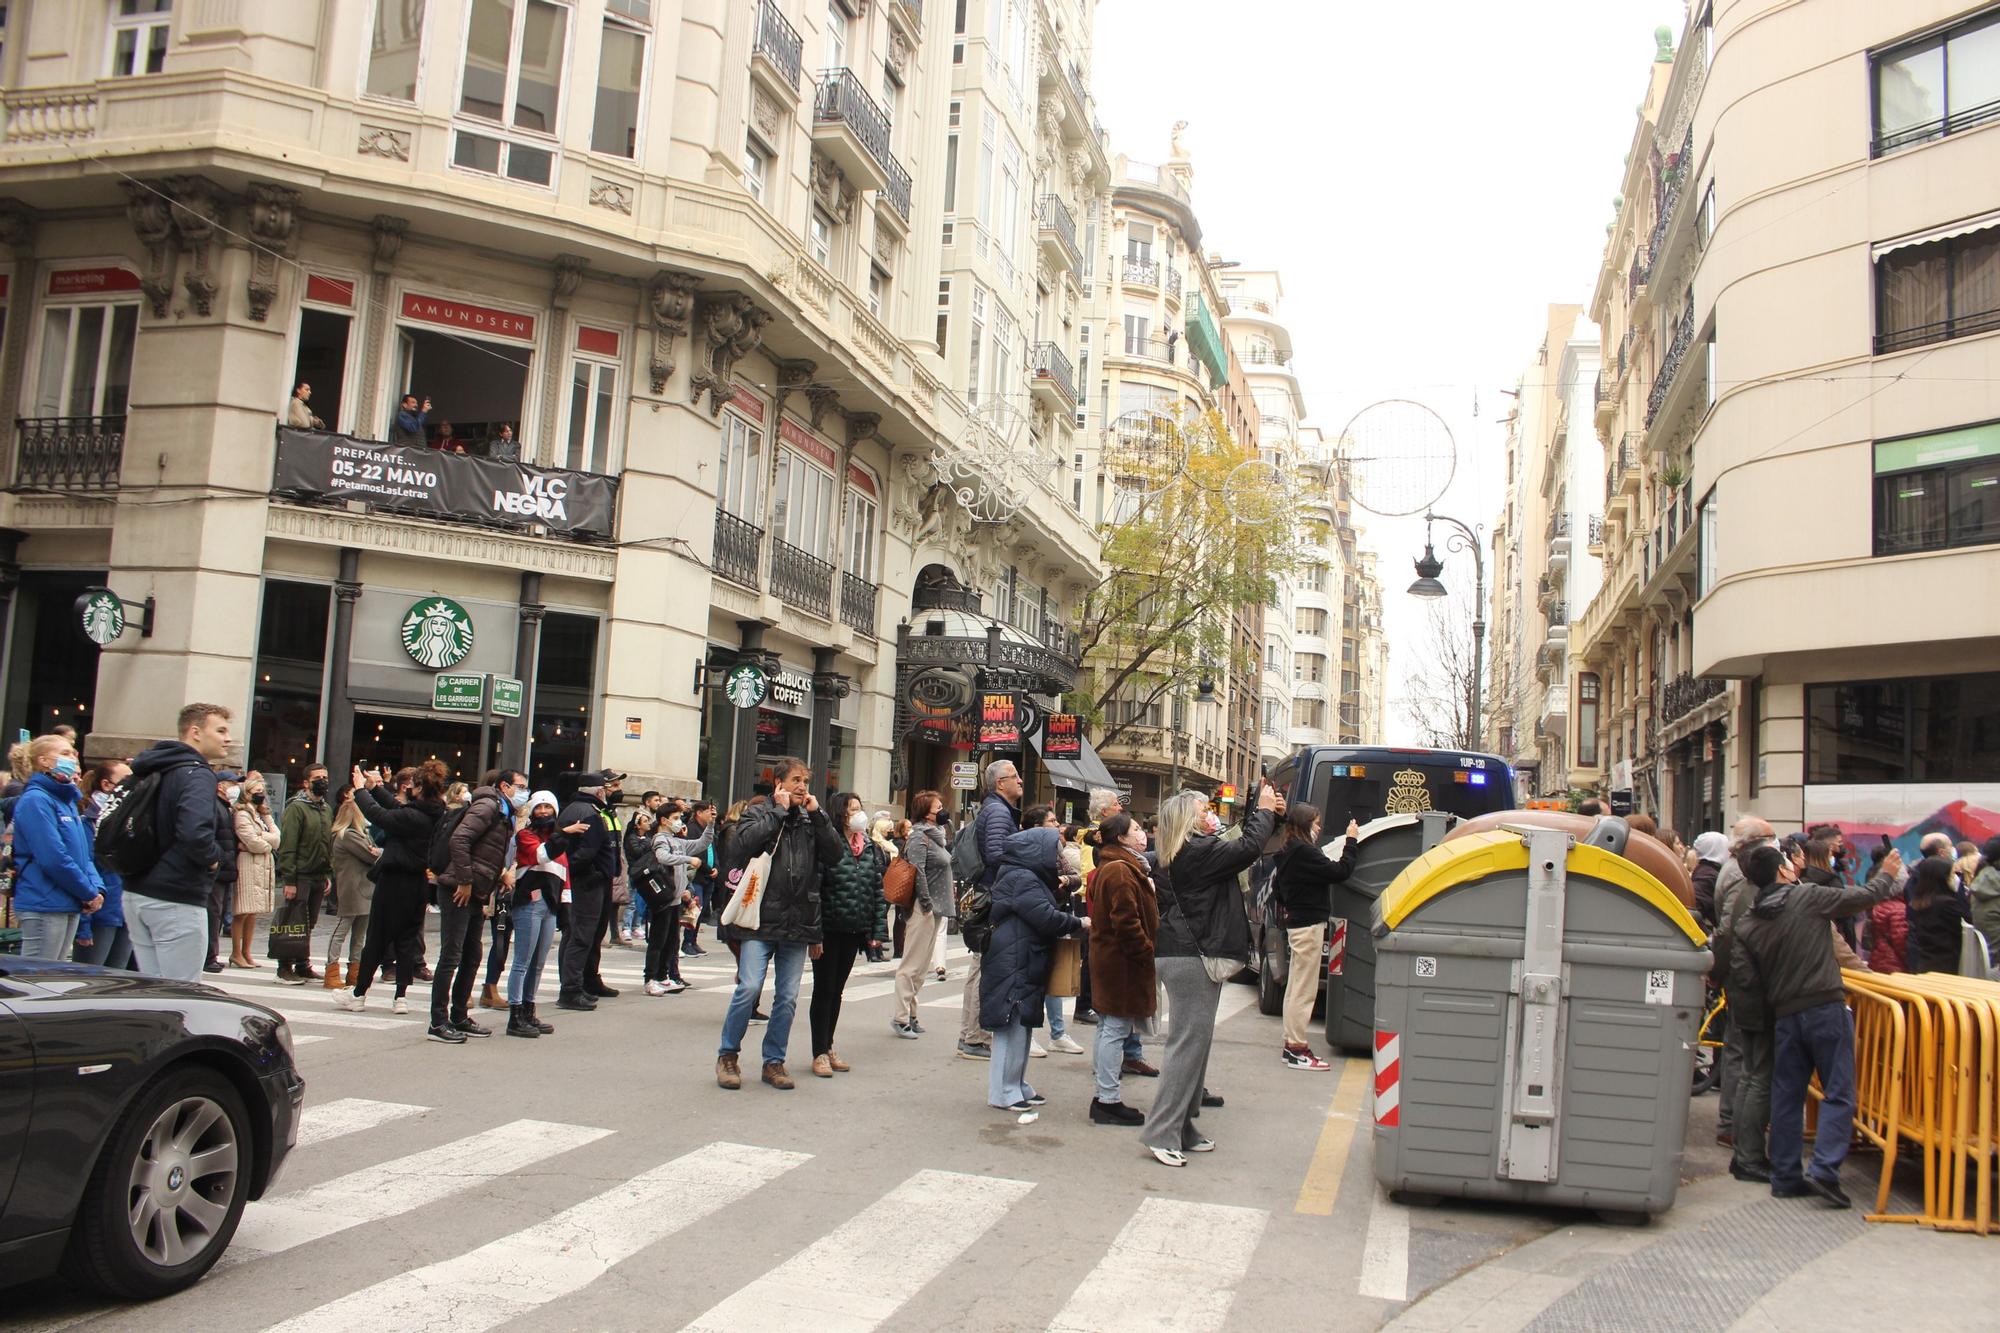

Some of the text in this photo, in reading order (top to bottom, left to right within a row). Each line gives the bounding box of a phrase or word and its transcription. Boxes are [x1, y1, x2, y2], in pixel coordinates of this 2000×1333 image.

[412, 303, 525, 331] AMUNDSEN
[333, 446, 416, 467] PREPÁRATE...
[332, 459, 437, 488] 05-22 MAYO
[331, 478, 429, 499] #PetamosLasLetras
[522, 473, 568, 500] VLC
[493, 490, 568, 521] NEGRA
[449, 678, 479, 686] CARRER
[767, 671, 812, 692] ARBUCKS
[436, 694, 479, 704] LES GARRIGUES
[774, 686, 803, 705] COFFEE
[990, 695, 1015, 709] FULL
[983, 709, 1014, 720] MONTY
[1049, 722, 1076, 733] MONTY
